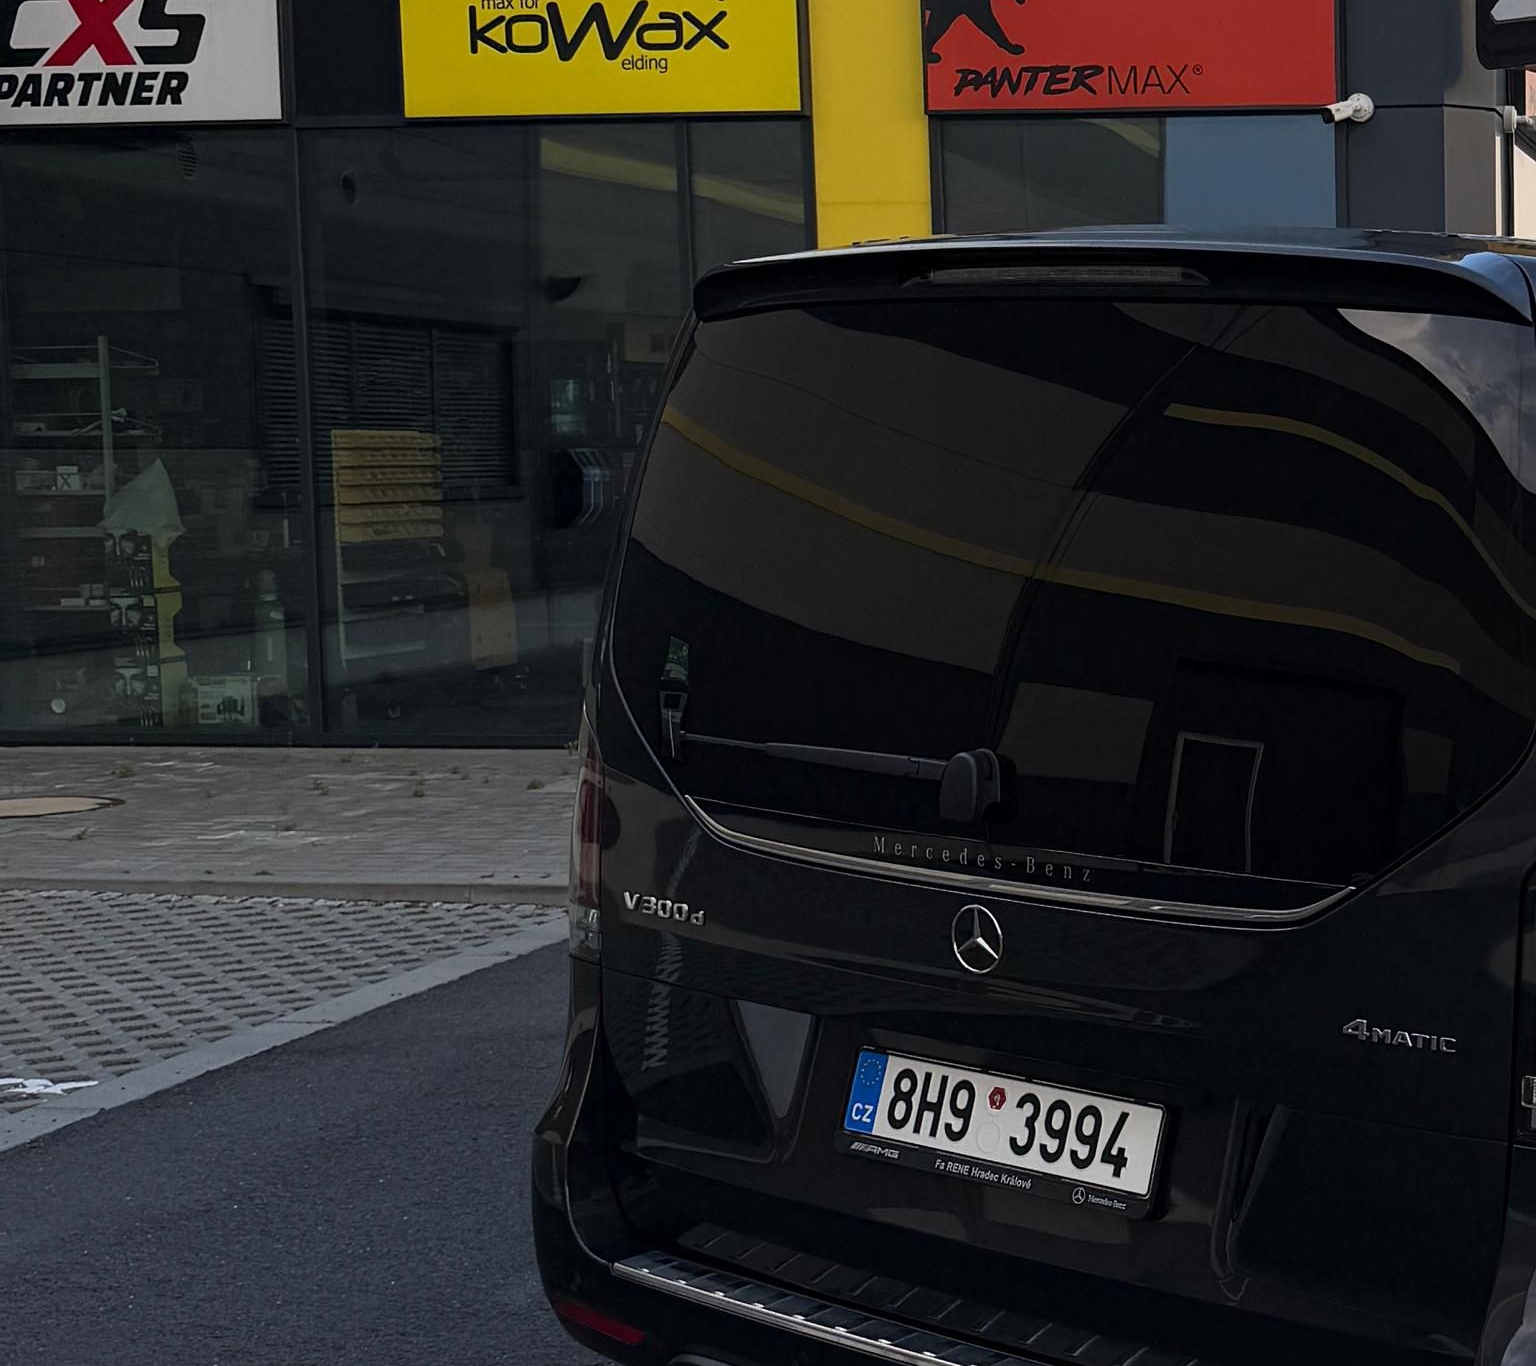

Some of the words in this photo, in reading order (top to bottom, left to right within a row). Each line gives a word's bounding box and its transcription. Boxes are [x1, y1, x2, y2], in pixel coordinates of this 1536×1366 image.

[0, 71, 189, 108] PARTNER
[873, 836, 1091, 882] Mercedes-Benz
[1343, 1019, 1456, 1052] 4MATIC
[851, 1103, 872, 1123] CZ
[887, 1068, 976, 1142] 8H9
[1009, 1093, 1130, 1178] 3994
[862, 1144, 899, 1159] AMG
[947, 1162, 969, 1175] RENE
[971, 1167, 998, 1182] Hradec
